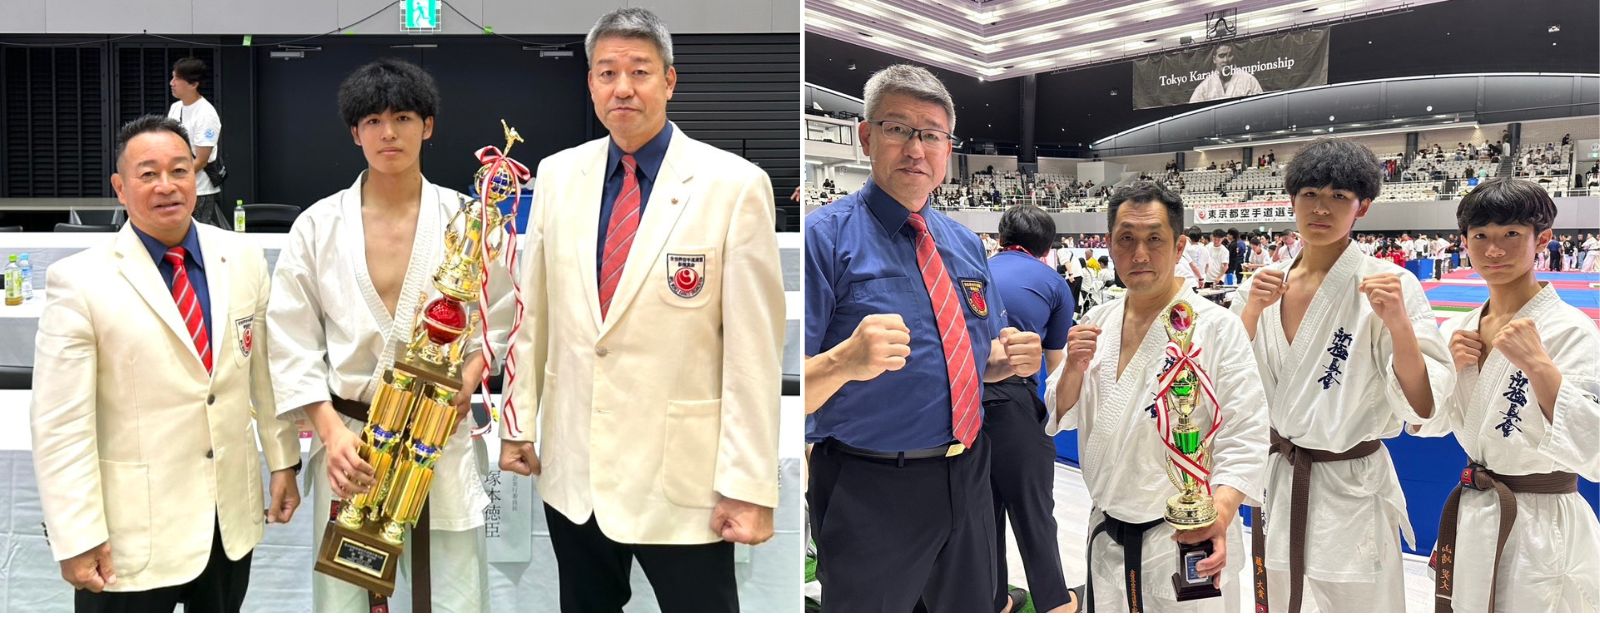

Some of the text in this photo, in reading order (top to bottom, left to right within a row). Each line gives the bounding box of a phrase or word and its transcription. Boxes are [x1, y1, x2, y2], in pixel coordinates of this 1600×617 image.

[1159, 57, 1295, 87] Tokyo Karate Championship
